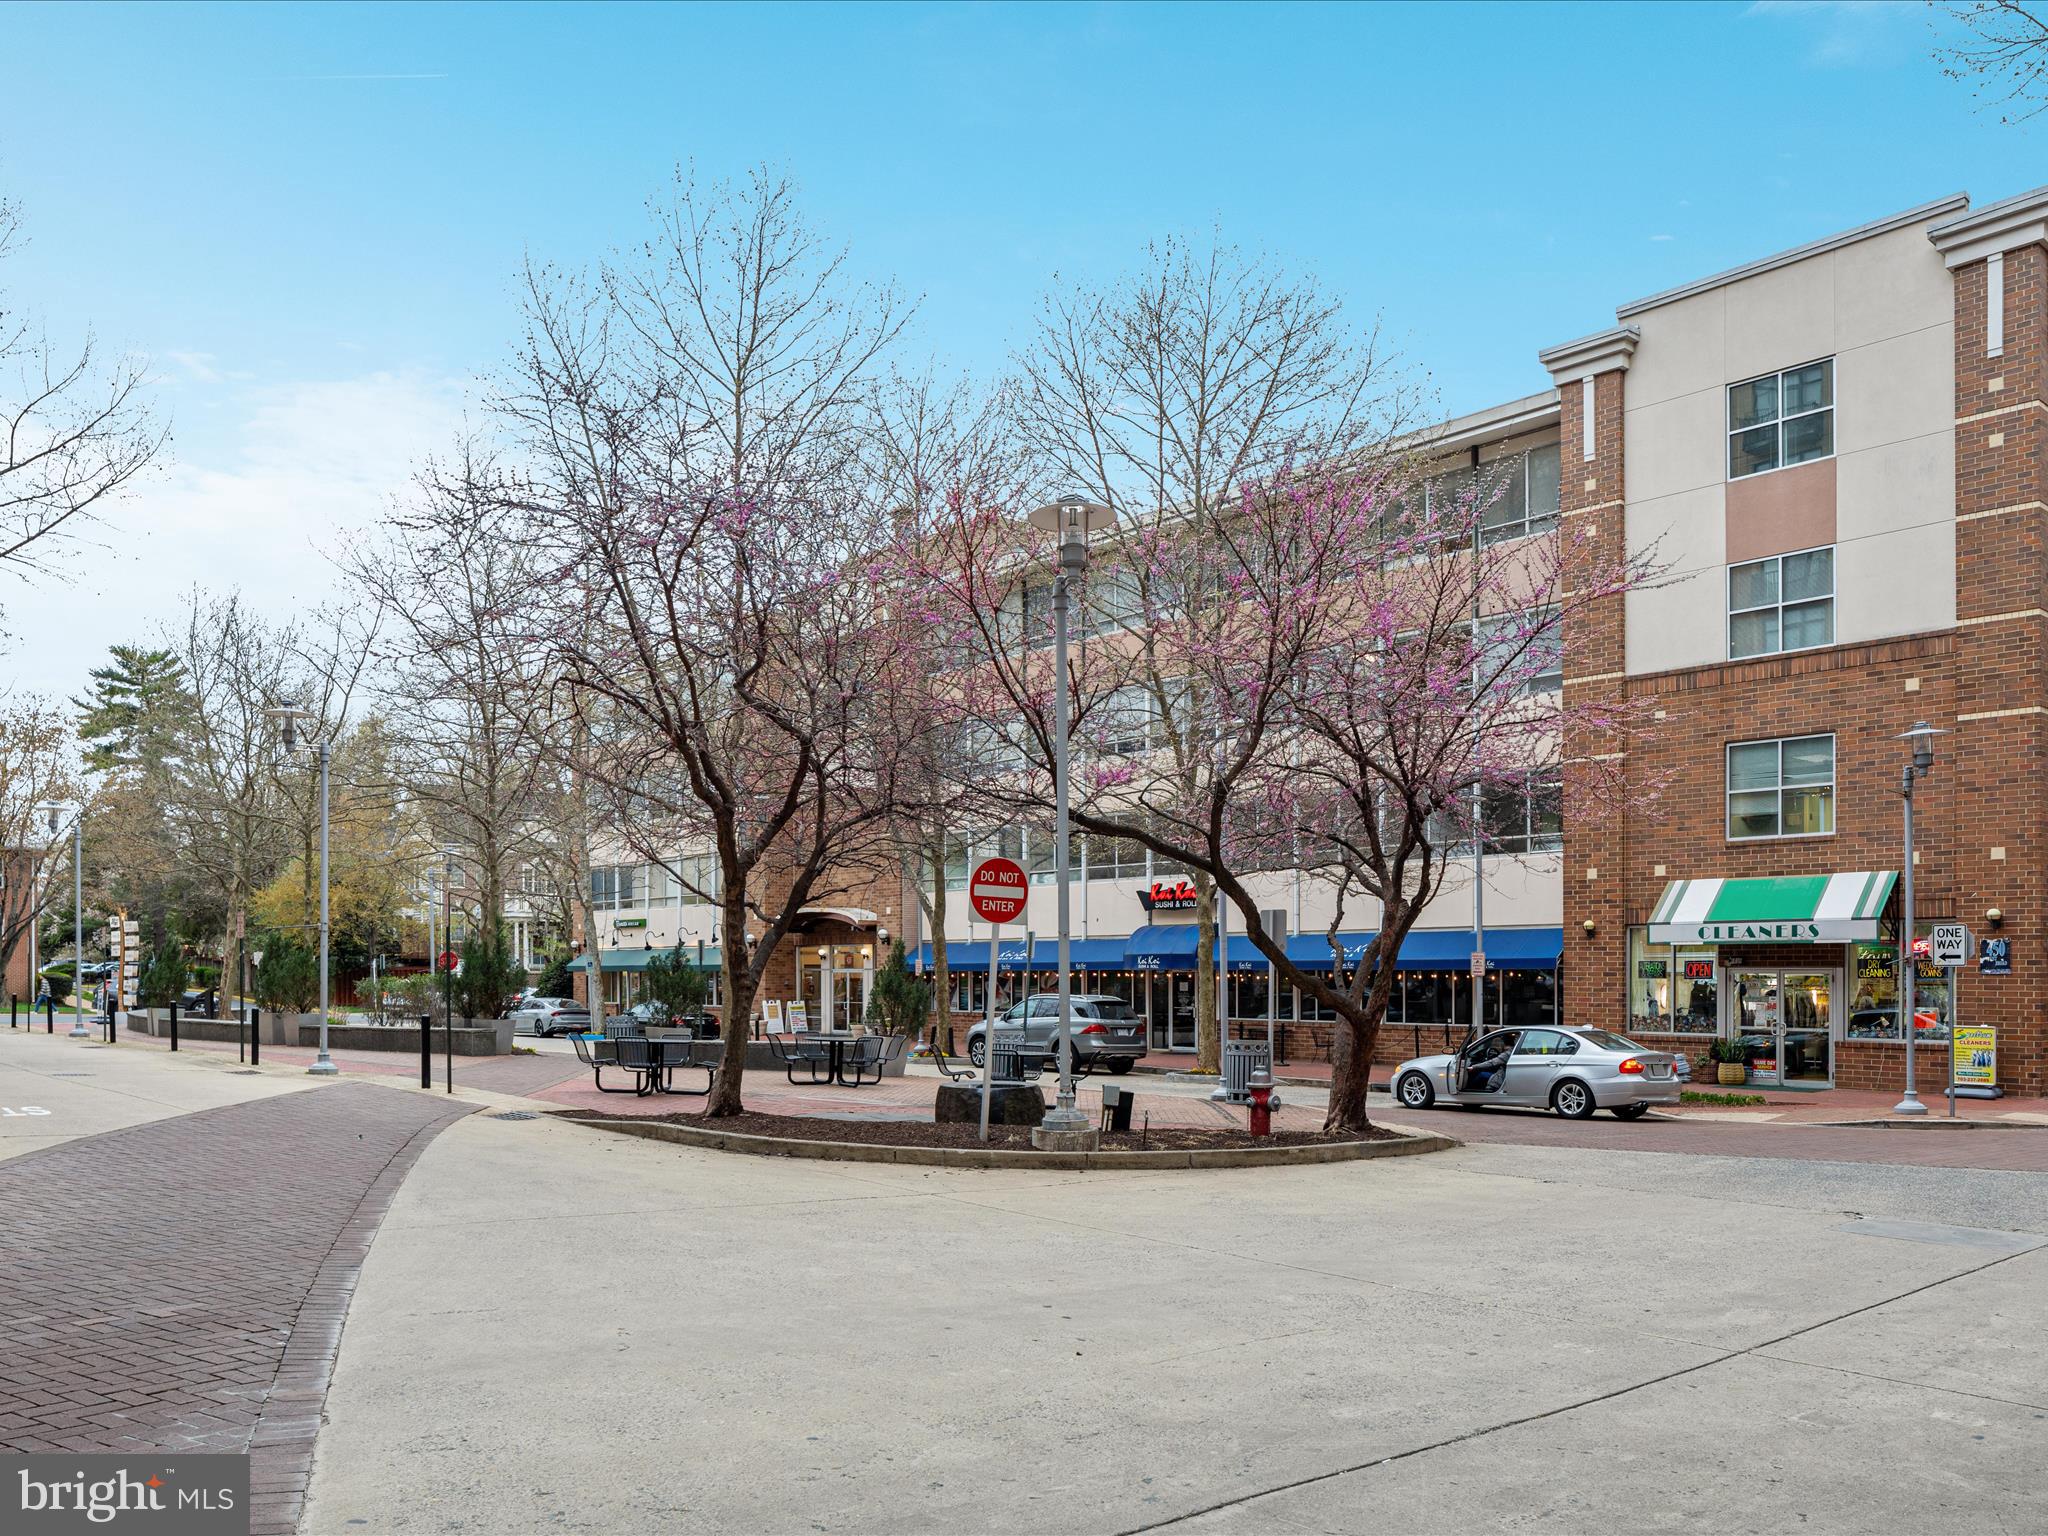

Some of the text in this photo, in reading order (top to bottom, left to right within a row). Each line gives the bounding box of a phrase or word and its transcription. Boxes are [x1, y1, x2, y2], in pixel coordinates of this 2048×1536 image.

[980, 870, 1020, 884] DO NOT
[1150, 882, 1173, 901] Koi
[982, 899, 1015, 912] ENTER
[1155, 900, 1174, 908] SUSHI
[1175, 900, 1180, 908] &
[1698, 924, 1819, 939] CLEANERS
[1937, 928, 1962, 938] ONE
[1936, 939, 1962, 949] WAY
[1867, 959, 1881, 969] DRY
[1686, 962, 1711, 977] OPEN
[1858, 968, 1891, 978] CLEANING
[1920, 969, 1943, 978] GOWNS
